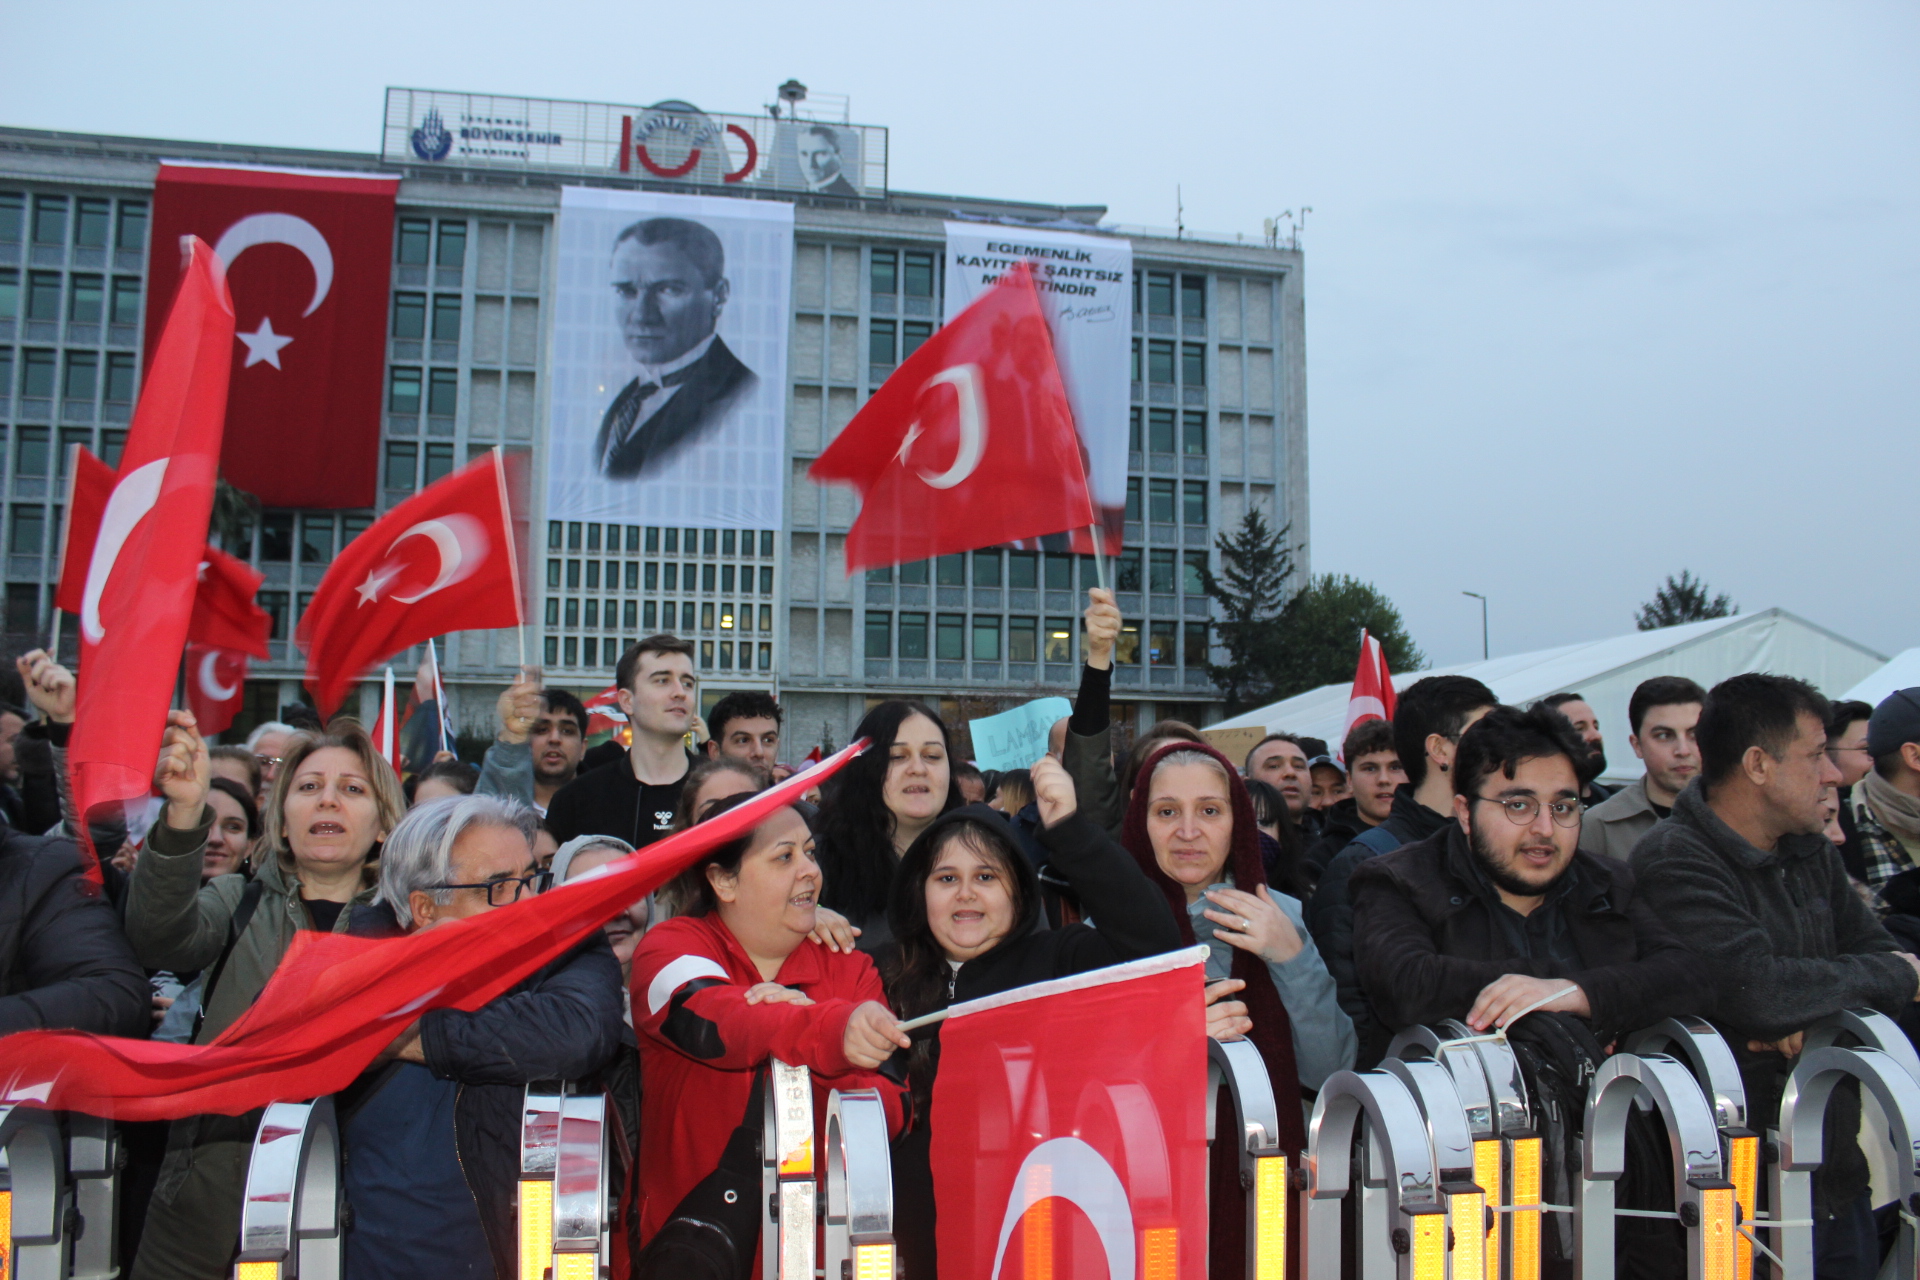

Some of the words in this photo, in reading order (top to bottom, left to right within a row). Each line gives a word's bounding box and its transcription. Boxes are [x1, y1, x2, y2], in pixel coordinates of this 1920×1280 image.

[986, 241, 1093, 263] EGEMENLİK
[956, 254, 1040, 274] KAYITSZ
[1044, 262, 1124, 283] ŞARTSIZ
